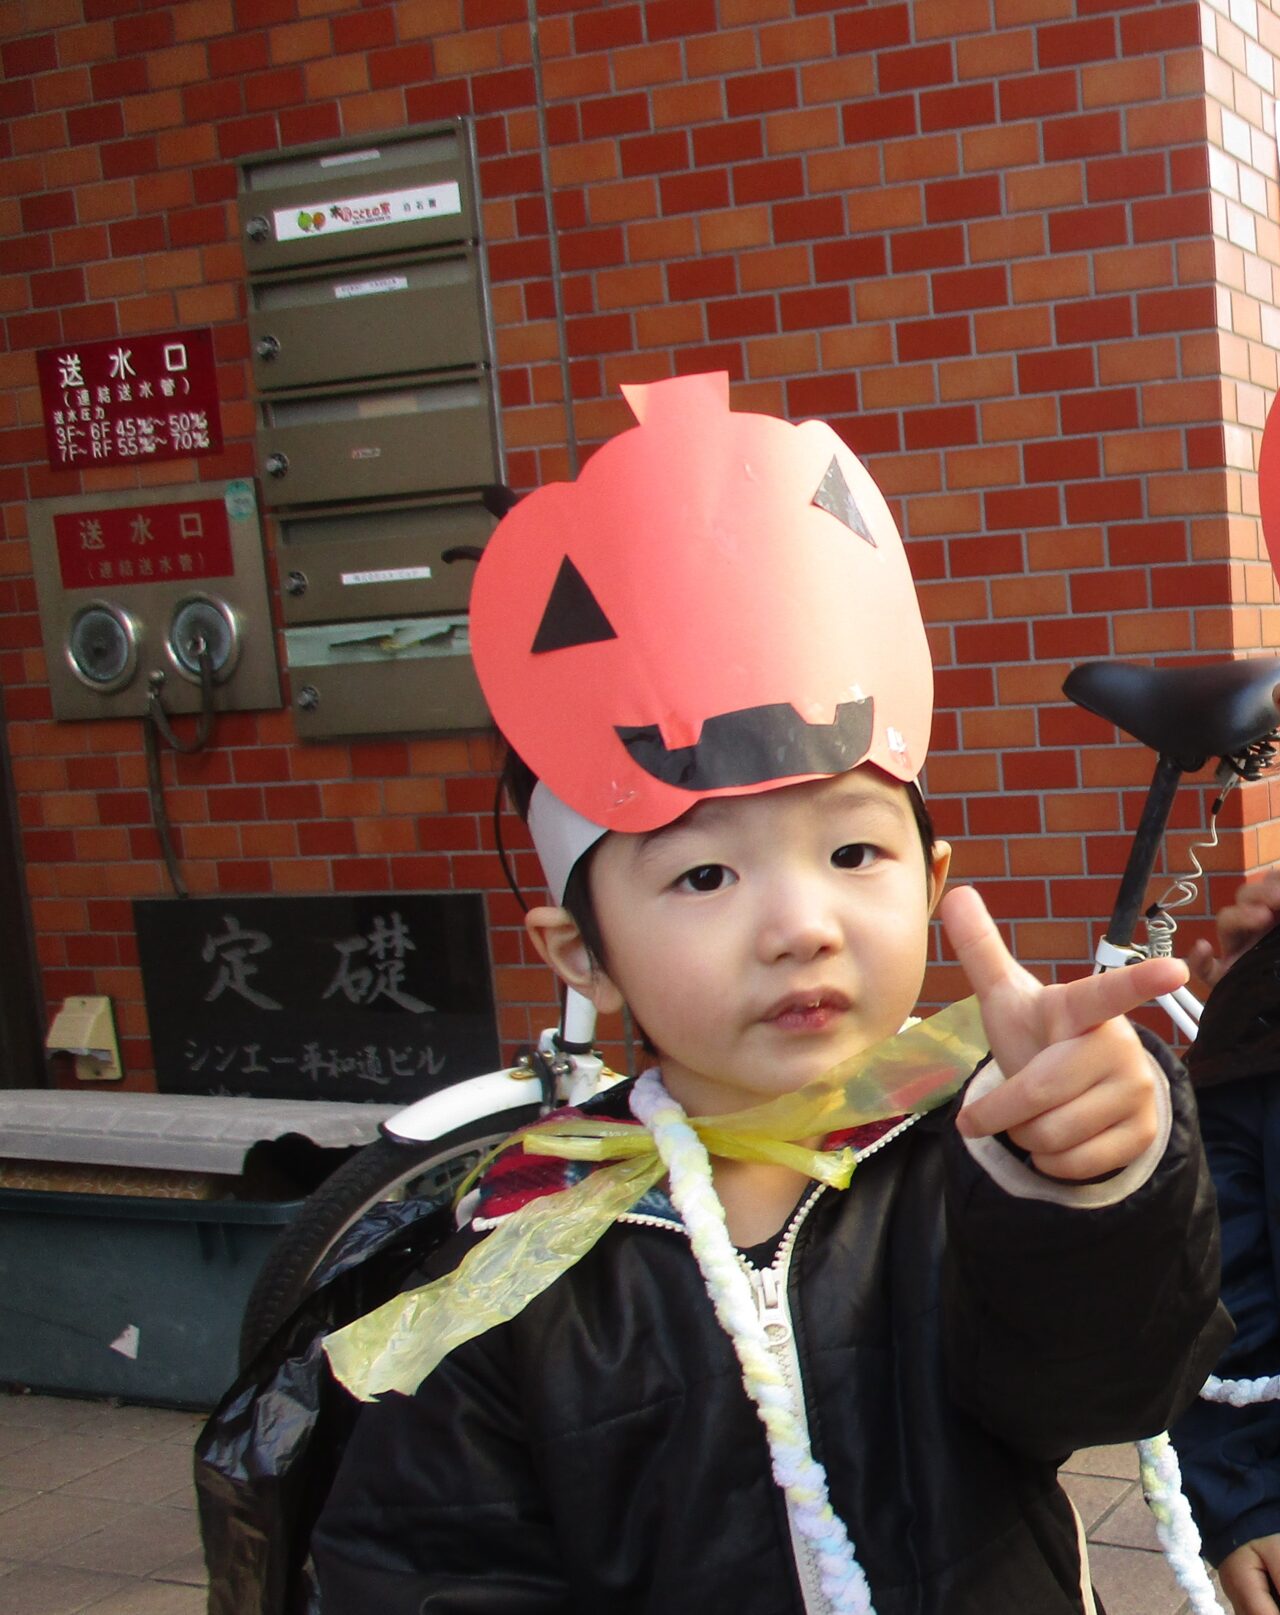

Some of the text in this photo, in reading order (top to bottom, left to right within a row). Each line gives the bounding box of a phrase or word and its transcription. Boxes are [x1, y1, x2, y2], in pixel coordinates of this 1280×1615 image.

[58, 344, 188, 388] 送水口
[53, 406, 105, 425] 送水圧力
[79, 513, 203, 549] 送水口
[202, 910, 438, 1014] 定礎
